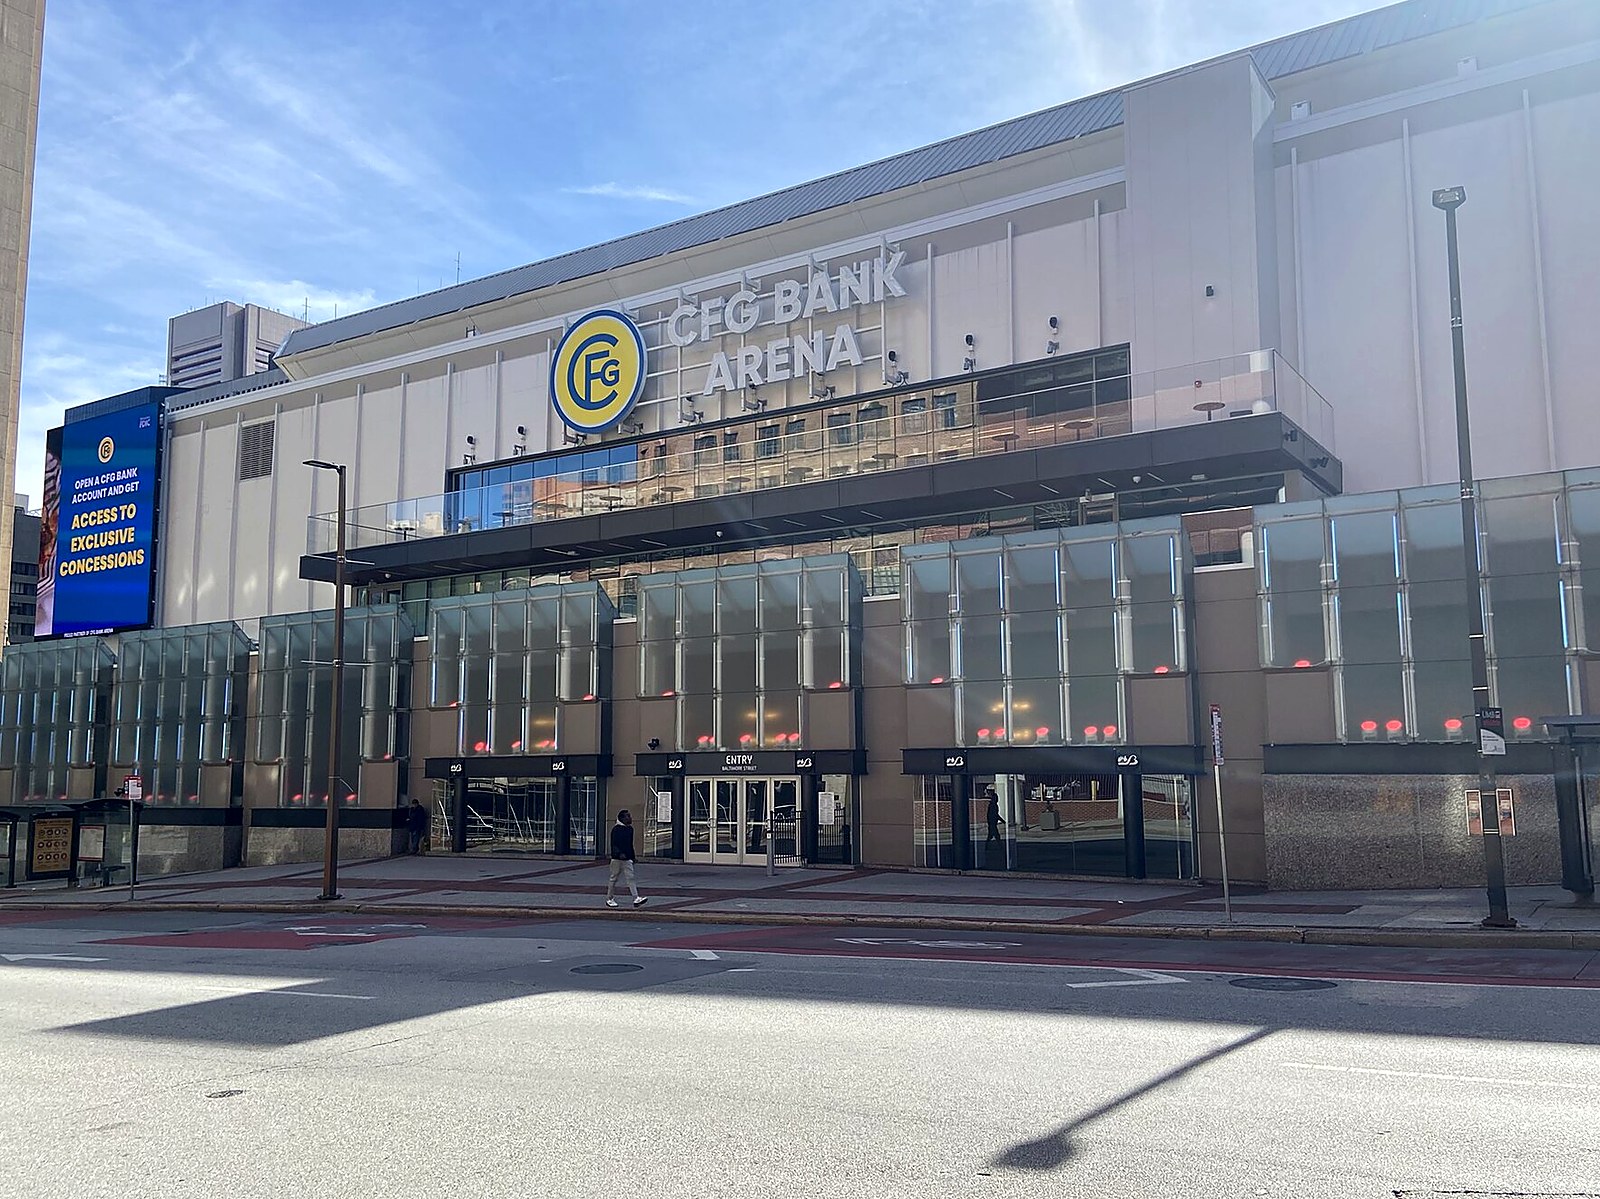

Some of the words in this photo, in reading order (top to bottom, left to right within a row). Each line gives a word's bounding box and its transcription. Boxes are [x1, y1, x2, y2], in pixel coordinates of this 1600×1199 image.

[667, 290, 762, 348] CFG
[774, 250, 907, 325] BANK
[703, 324, 864, 396] ARENA
[75, 477, 94, 490] OPEN
[94, 476, 100, 486] A
[100, 473, 115, 484] CFG
[116, 467, 138, 480] BANK
[72, 487, 108, 504] ACCOUNT
[107, 484, 124, 497] AND
[125, 481, 140, 493] GET
[71, 507, 118, 530] ACCESS
[119, 503, 137, 521] TO
[71, 527, 135, 553] EXCLUSIVE
[60, 549, 145, 577] CONCESSIONS
[725, 755, 753, 765] ENTRY
